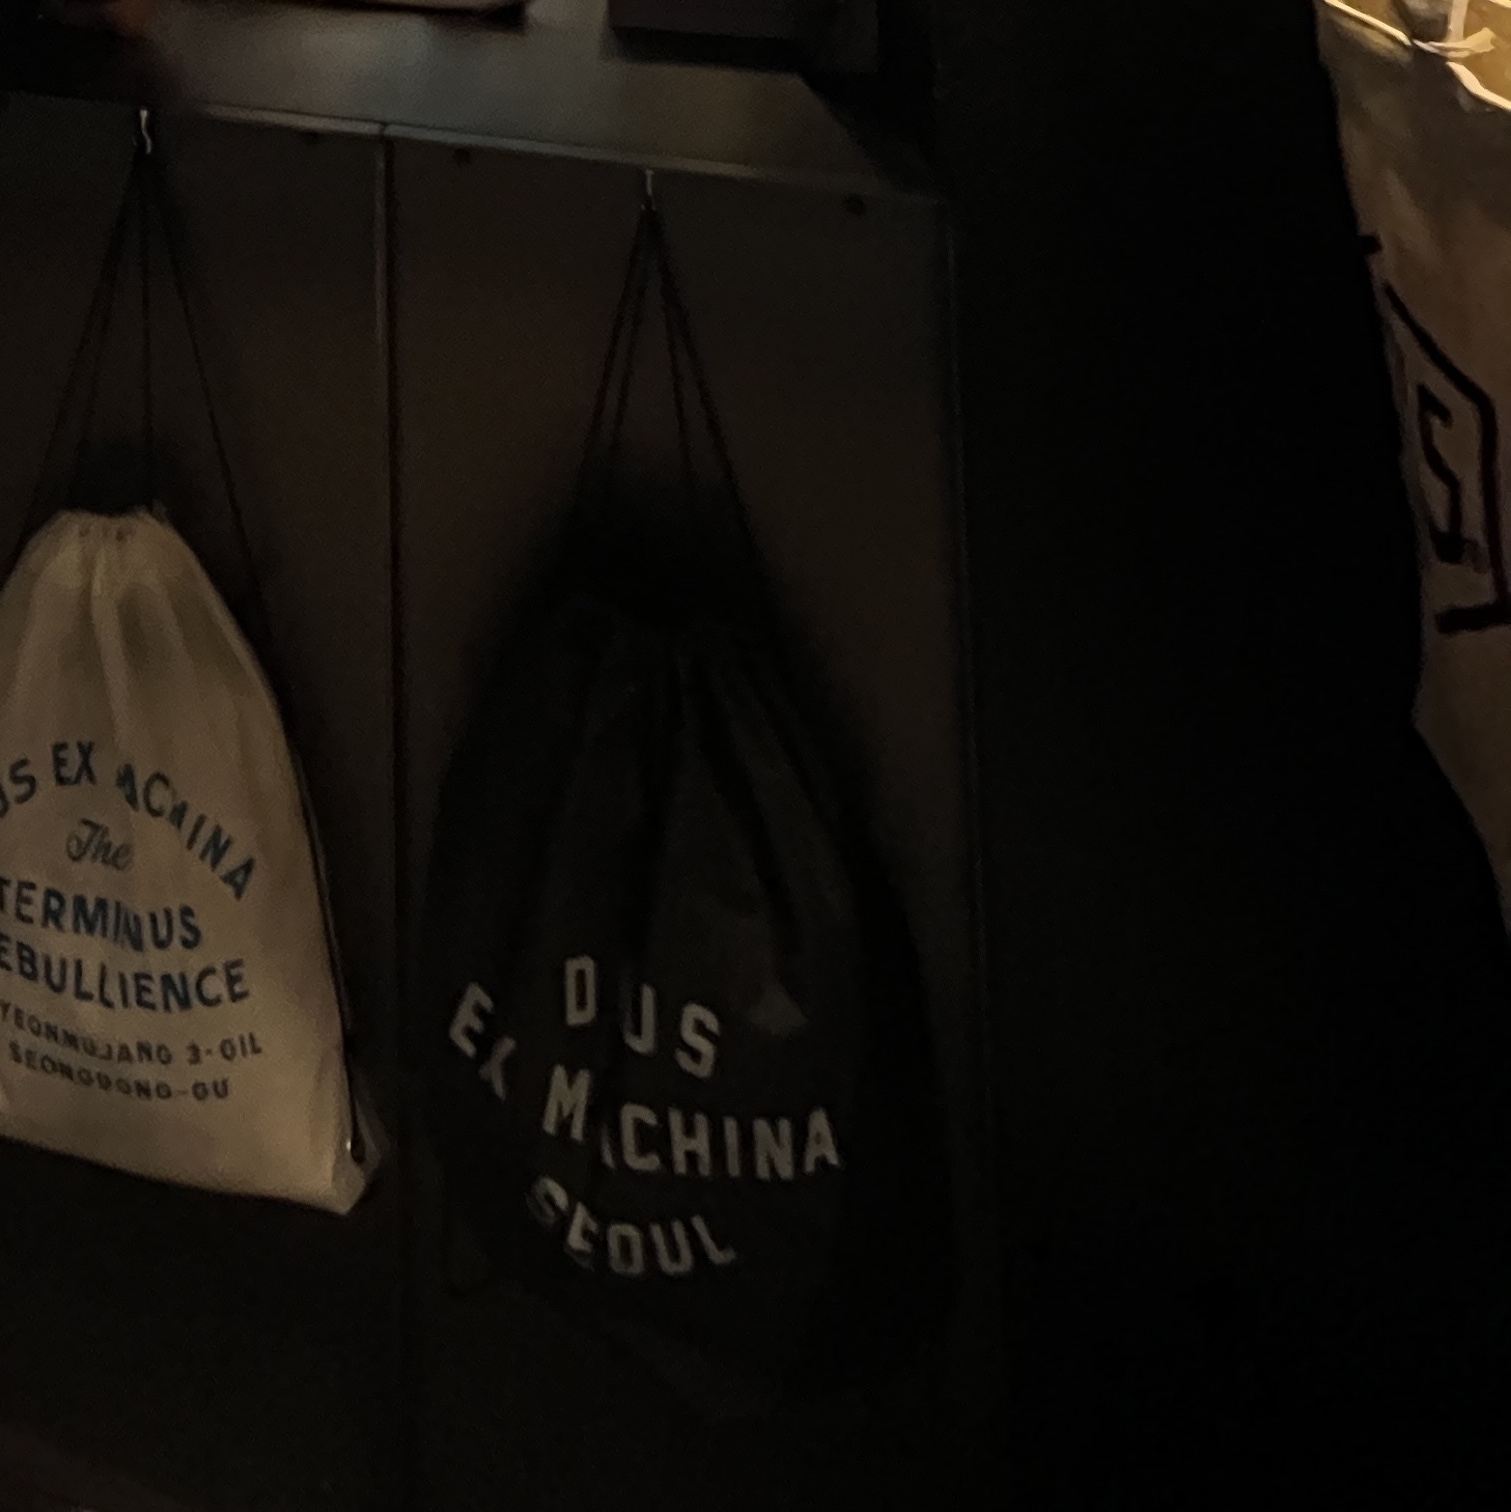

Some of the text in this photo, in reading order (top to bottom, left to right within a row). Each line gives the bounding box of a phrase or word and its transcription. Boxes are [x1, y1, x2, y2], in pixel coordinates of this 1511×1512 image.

[51, 741, 97, 786] EX
[66, 817, 133, 872] The
[562, 952, 723, 1081] DUS
